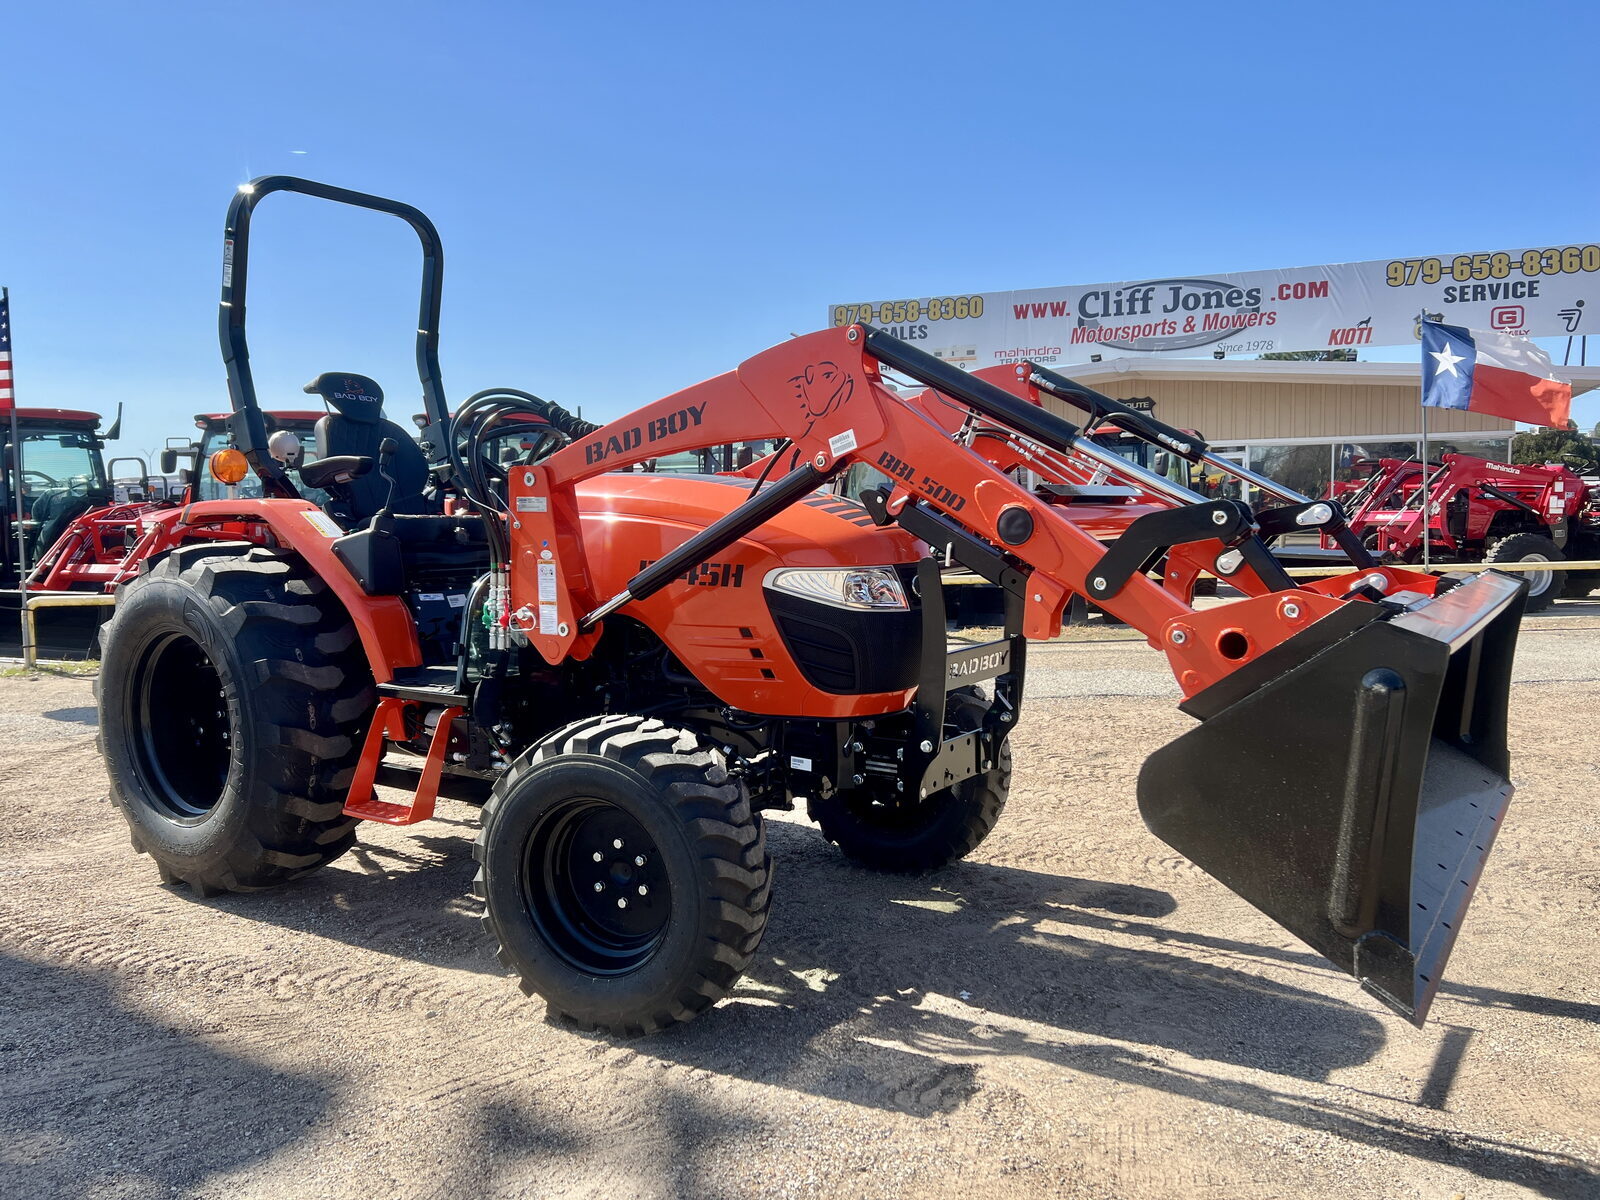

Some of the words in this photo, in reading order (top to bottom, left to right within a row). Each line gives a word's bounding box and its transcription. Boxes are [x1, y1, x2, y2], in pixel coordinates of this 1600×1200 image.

[1386, 245, 1600, 287] 979-658-8360
[1078, 287, 1156, 318] Cliff
[1162, 286, 1262, 314] Jones
[1271, 281, 1329, 301] .COM
[1443, 280, 1540, 303] SERVICE
[834, 295, 984, 326] 979-658-8360
[1070, 318, 1178, 344] Motorsports
[1182, 315, 1197, 333] &
[1202, 311, 1277, 331] Mowers
[1328, 327, 1373, 346] KIOTI
[994, 346, 1062, 358] mahindra
[1217, 341, 1244, 352] Since
[1246, 340, 1274, 351] 1978
[334, 392, 356, 400] BAD
[358, 394, 378, 402] BOY
[1124, 401, 1150, 409] OUTE
[585, 427, 642, 465] BAD
[648, 401, 707, 442] BOY
[1485, 462, 1520, 475] Mahindra
[876, 451, 916, 485] BBL
[918, 476, 967, 512] 500
